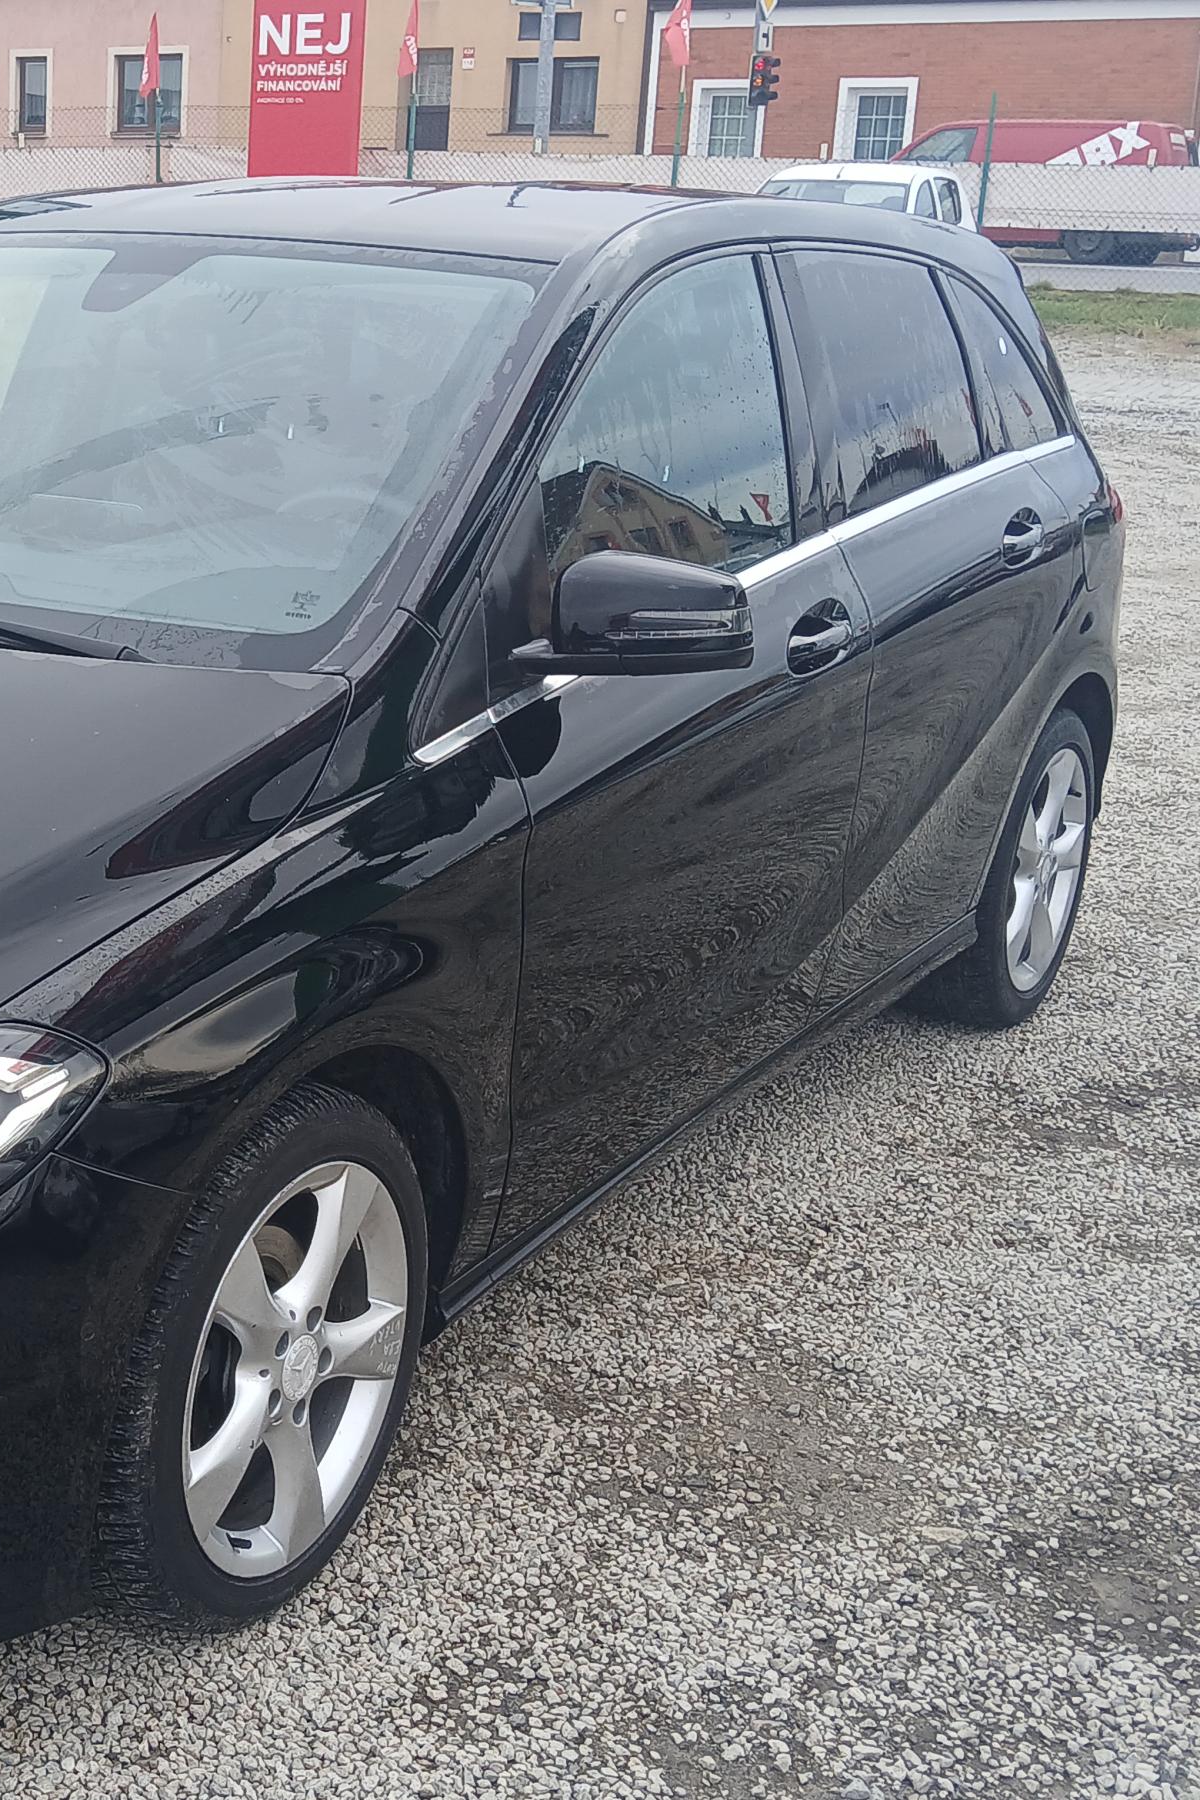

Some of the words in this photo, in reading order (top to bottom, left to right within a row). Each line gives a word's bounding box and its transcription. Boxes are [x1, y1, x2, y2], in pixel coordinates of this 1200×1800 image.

[258, 12, 351, 55] NEJ
[258, 59, 348, 76] VÝHODNĚJŠÍ
[256, 77, 342, 92] FINANCOVÁNÍ
